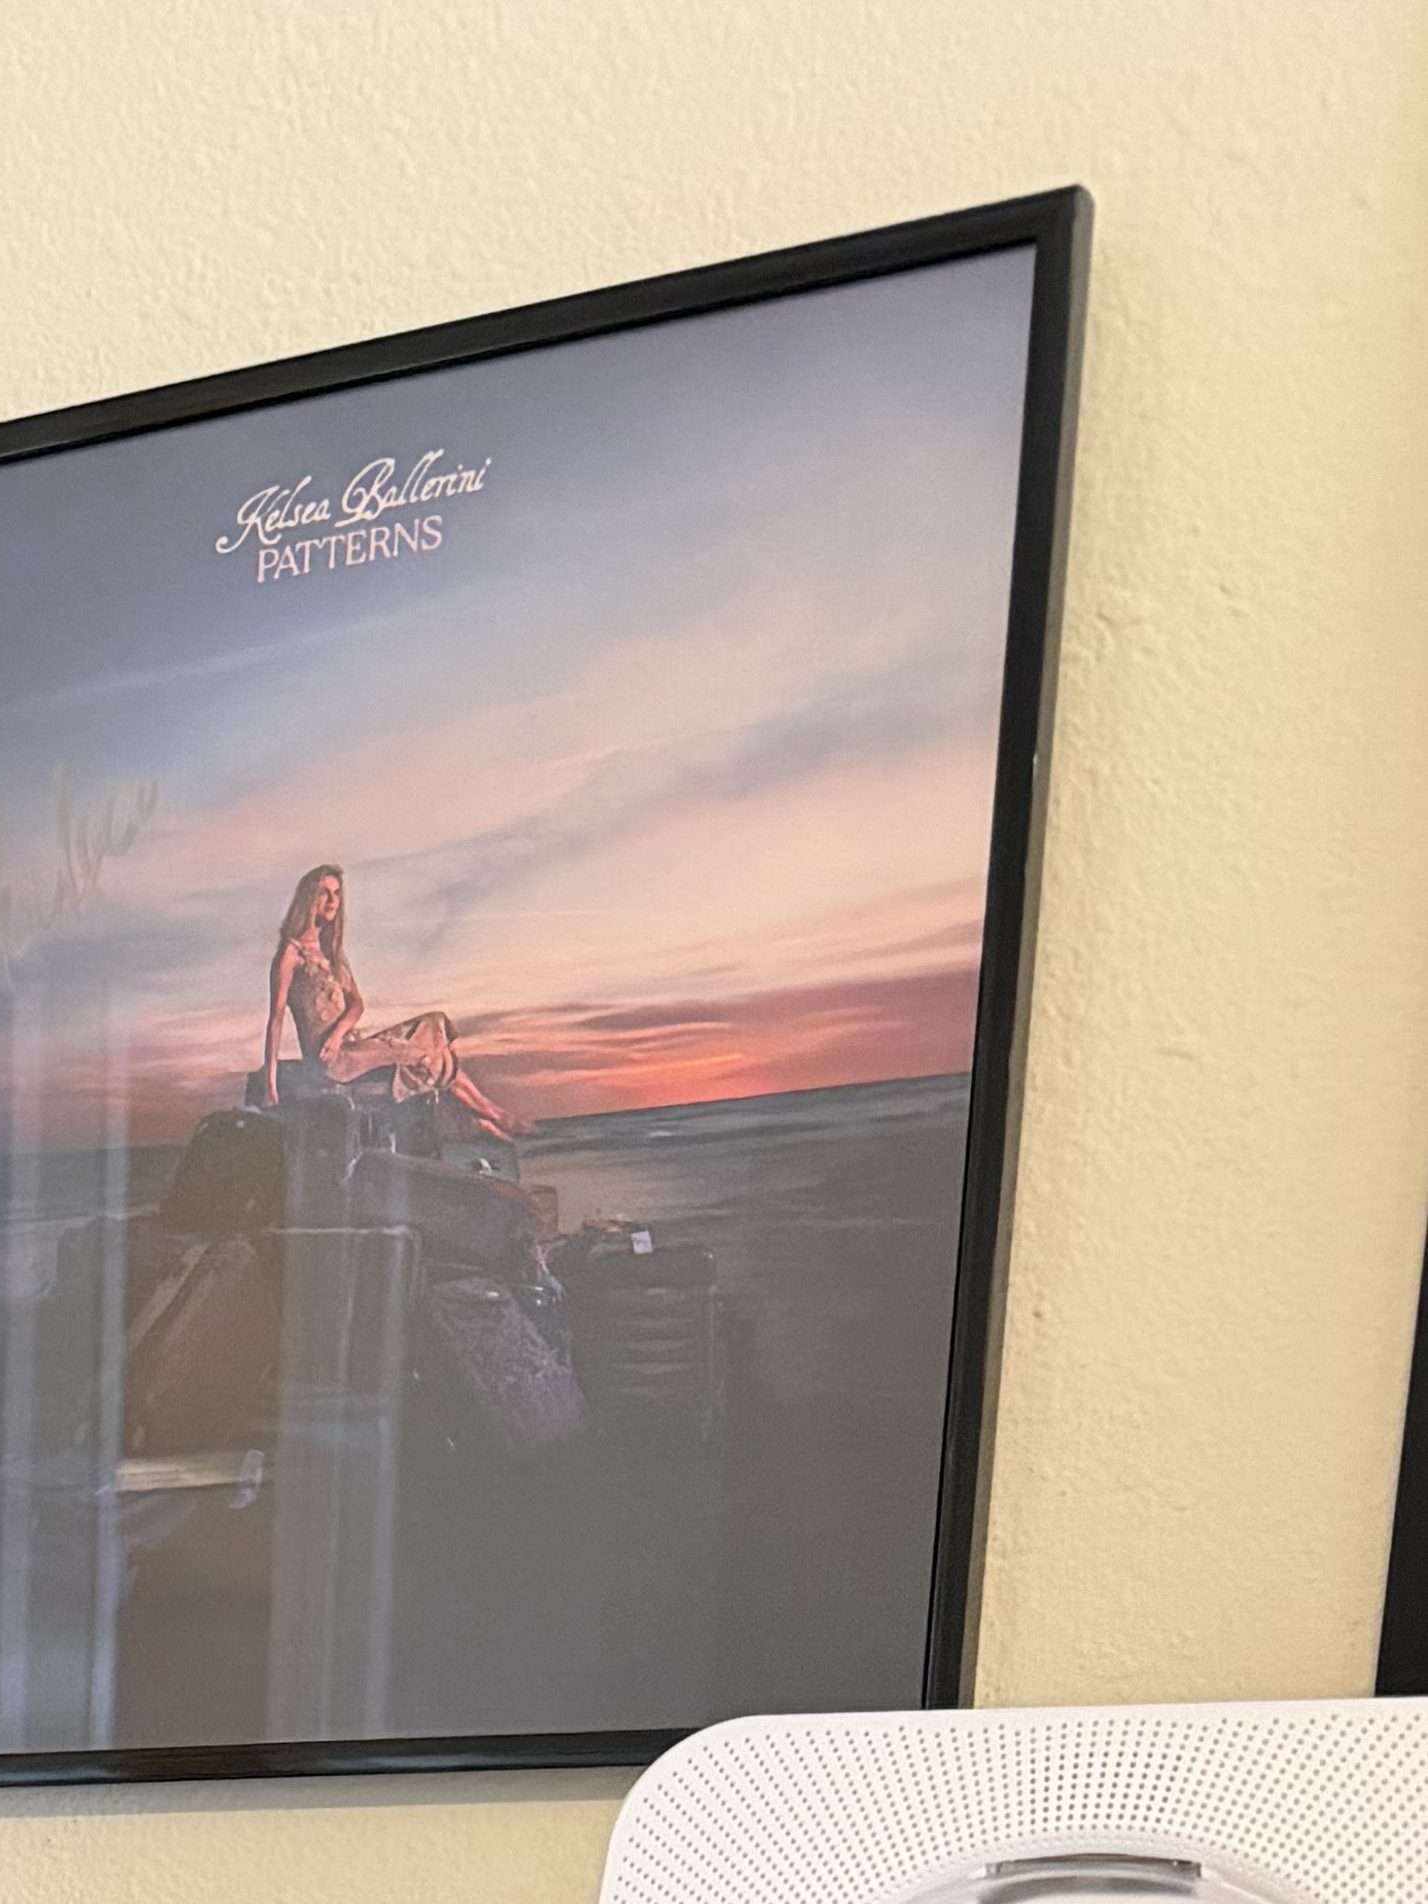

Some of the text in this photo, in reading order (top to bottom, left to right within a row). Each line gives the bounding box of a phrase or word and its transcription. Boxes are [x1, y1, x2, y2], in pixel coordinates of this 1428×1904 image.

[215, 448, 492, 554] Kelsea Ballerini
[256, 514, 443, 583] PATTERNS
